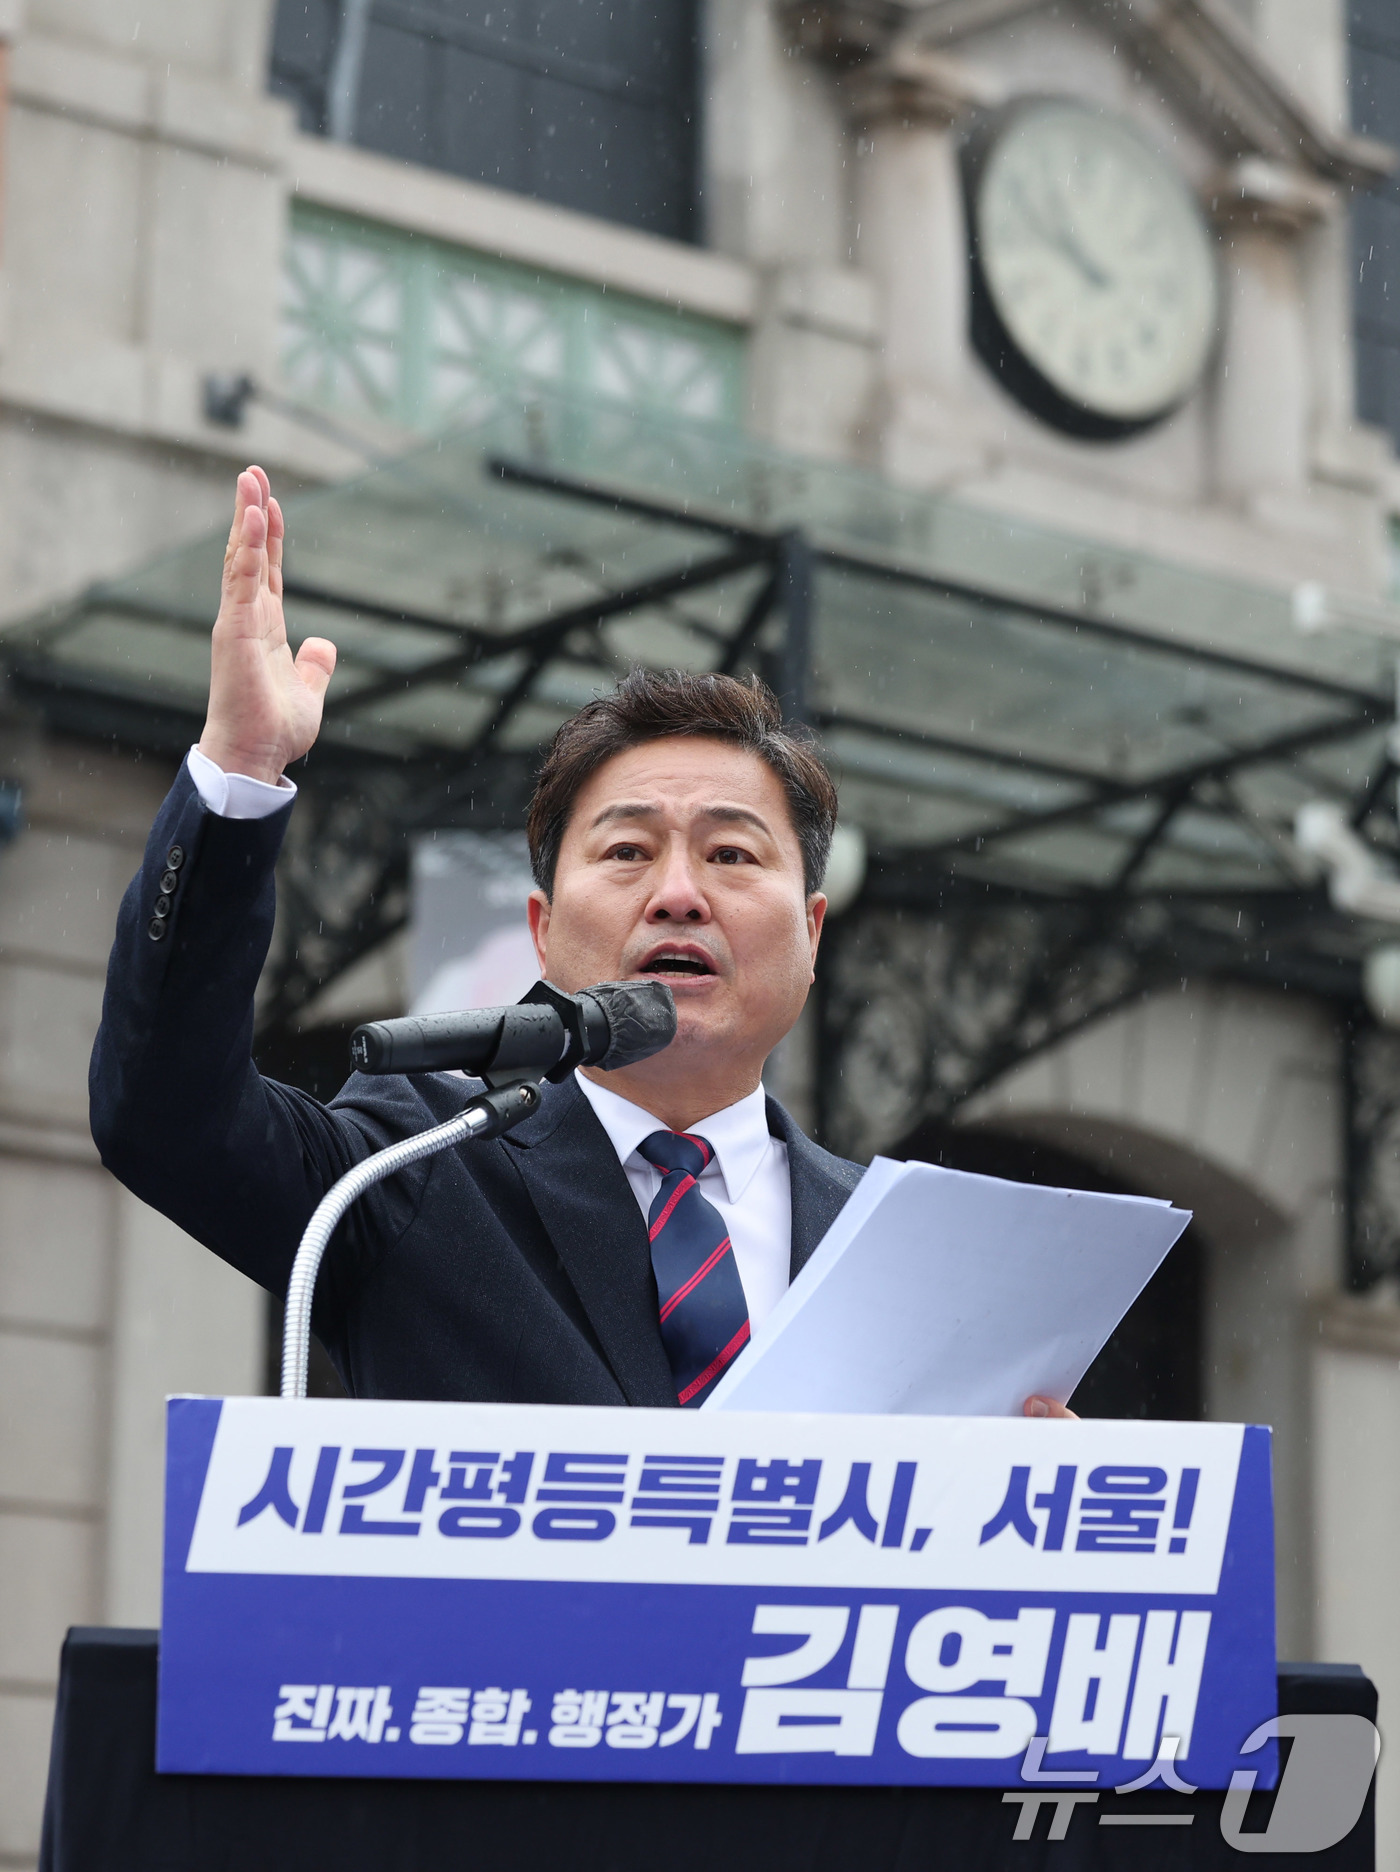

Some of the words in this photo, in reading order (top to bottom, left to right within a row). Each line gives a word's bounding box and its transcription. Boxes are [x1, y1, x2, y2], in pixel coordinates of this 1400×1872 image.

[236, 1446, 933, 1552] 시간평등특별시,
[979, 1465, 1201, 1554] 서울!
[735, 1604, 1212, 1760] 김영배
